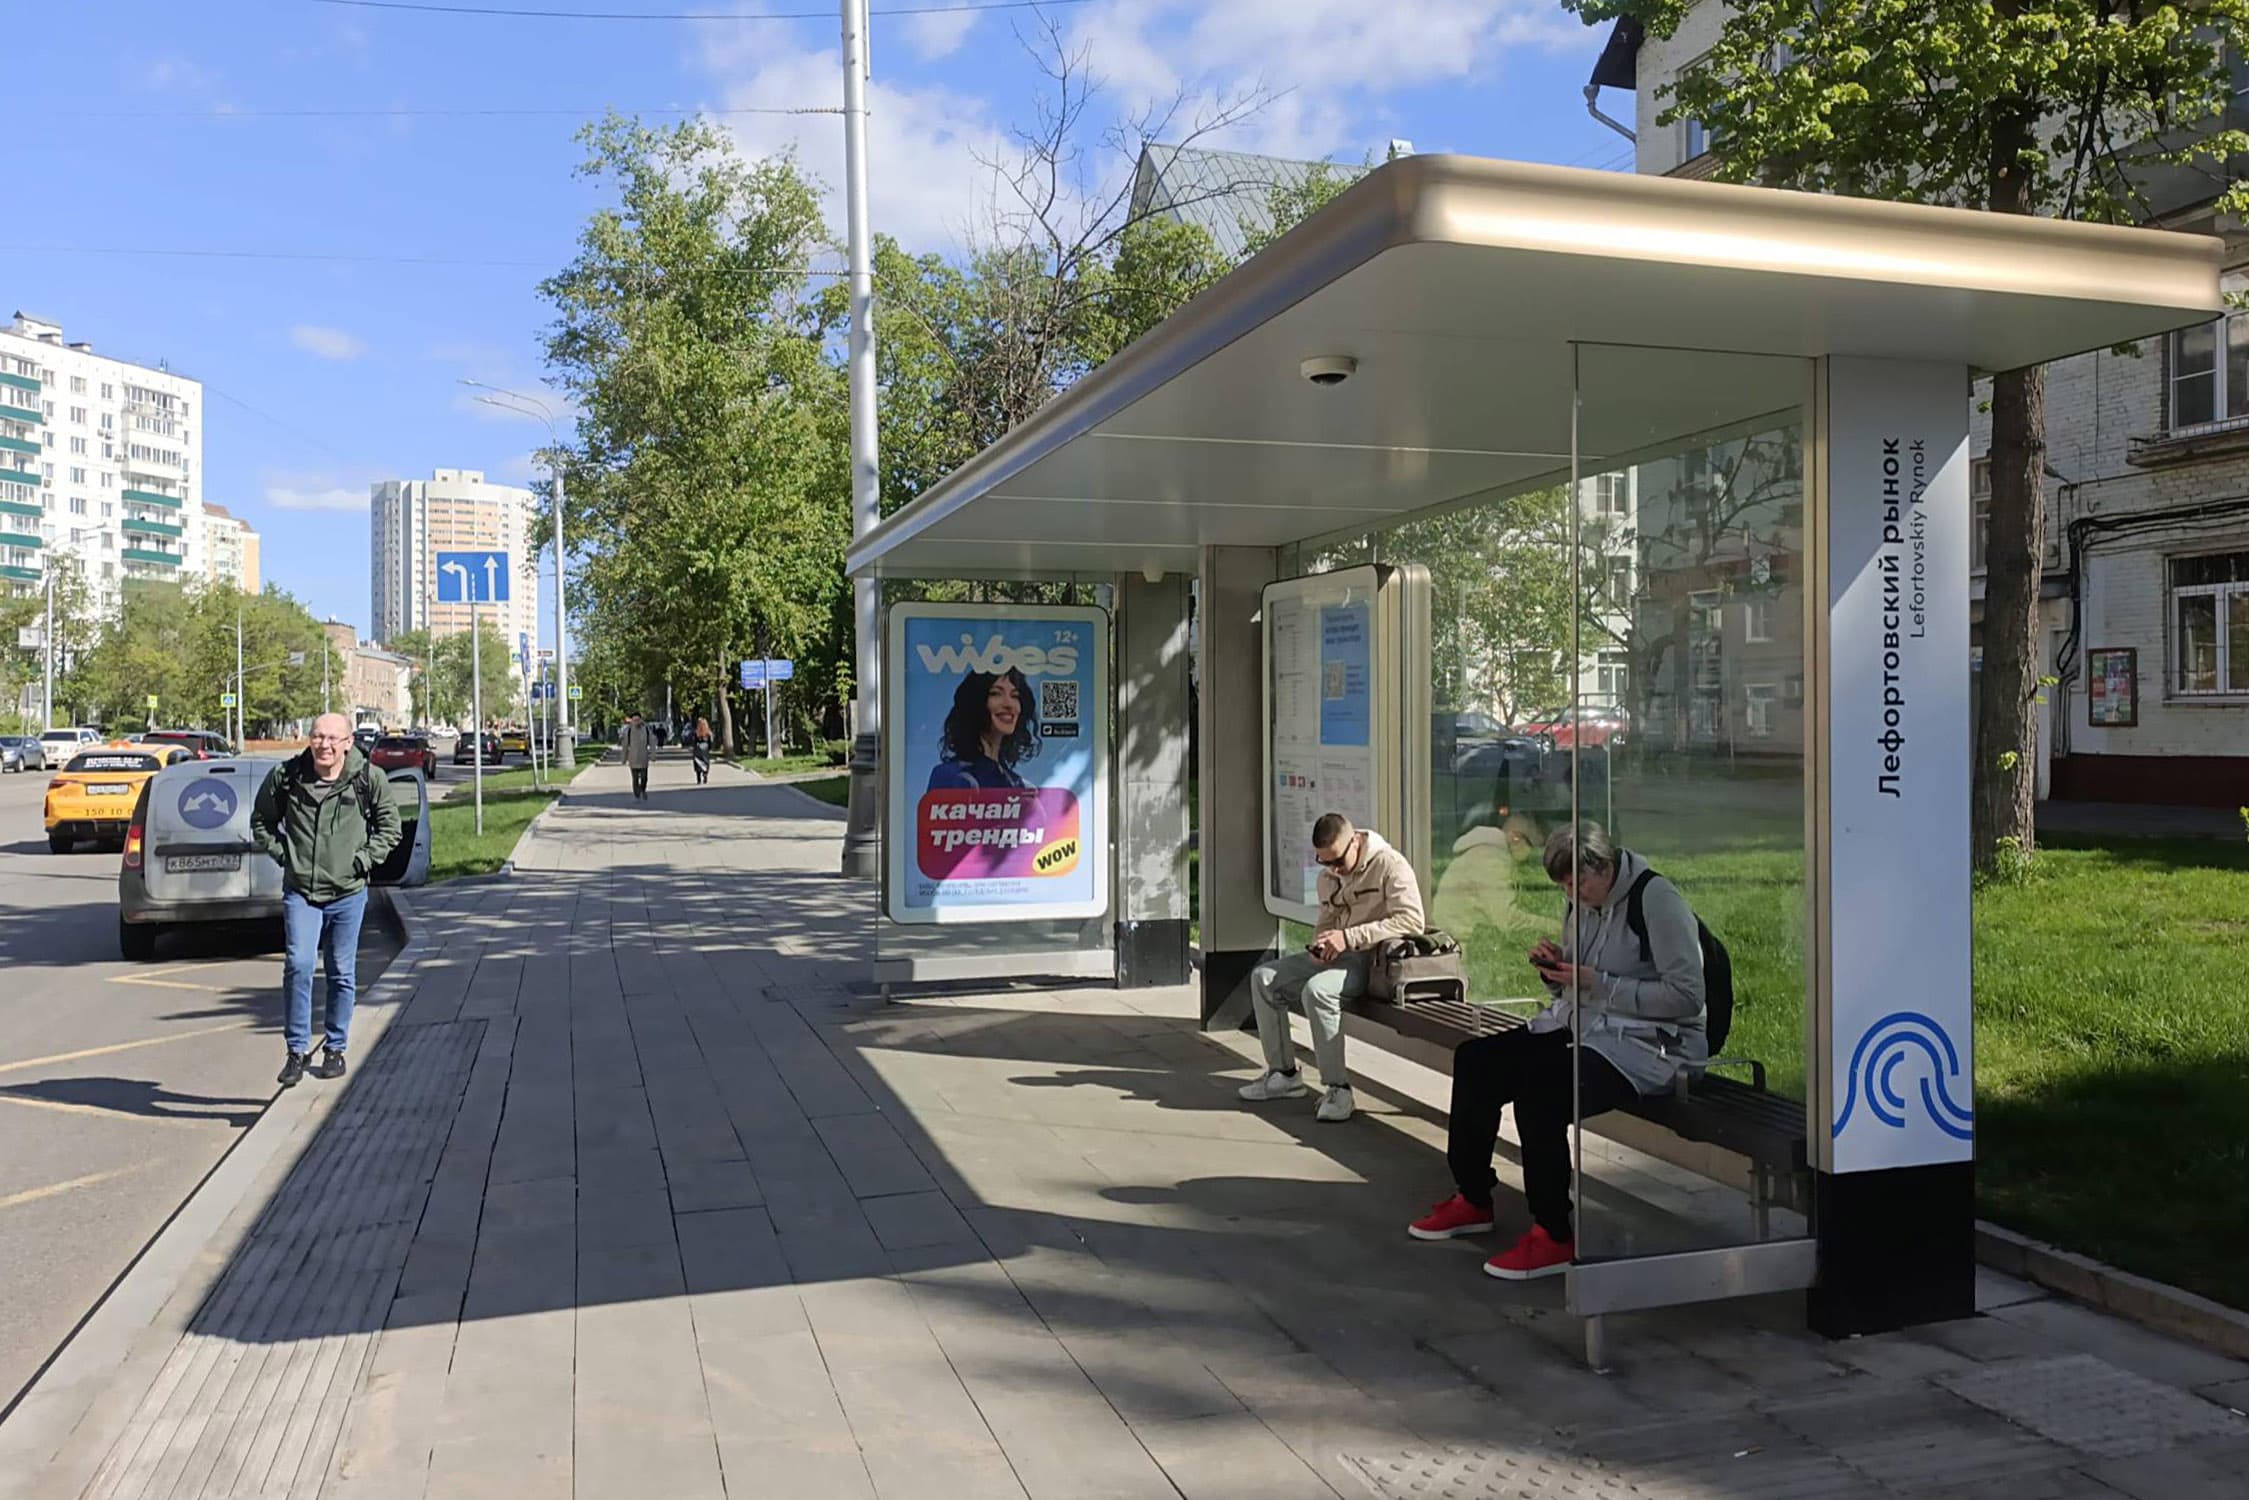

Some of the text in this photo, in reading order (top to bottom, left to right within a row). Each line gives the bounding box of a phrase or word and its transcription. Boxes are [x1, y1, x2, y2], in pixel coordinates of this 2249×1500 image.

[1910, 439, 1929, 638] Lefortovskiy Rynok
[1877, 437, 1905, 798] Лефортовский рынок
[1054, 630, 1079, 643] 12+
[930, 797, 1020, 821] качай
[930, 827, 1044, 852] тренды
